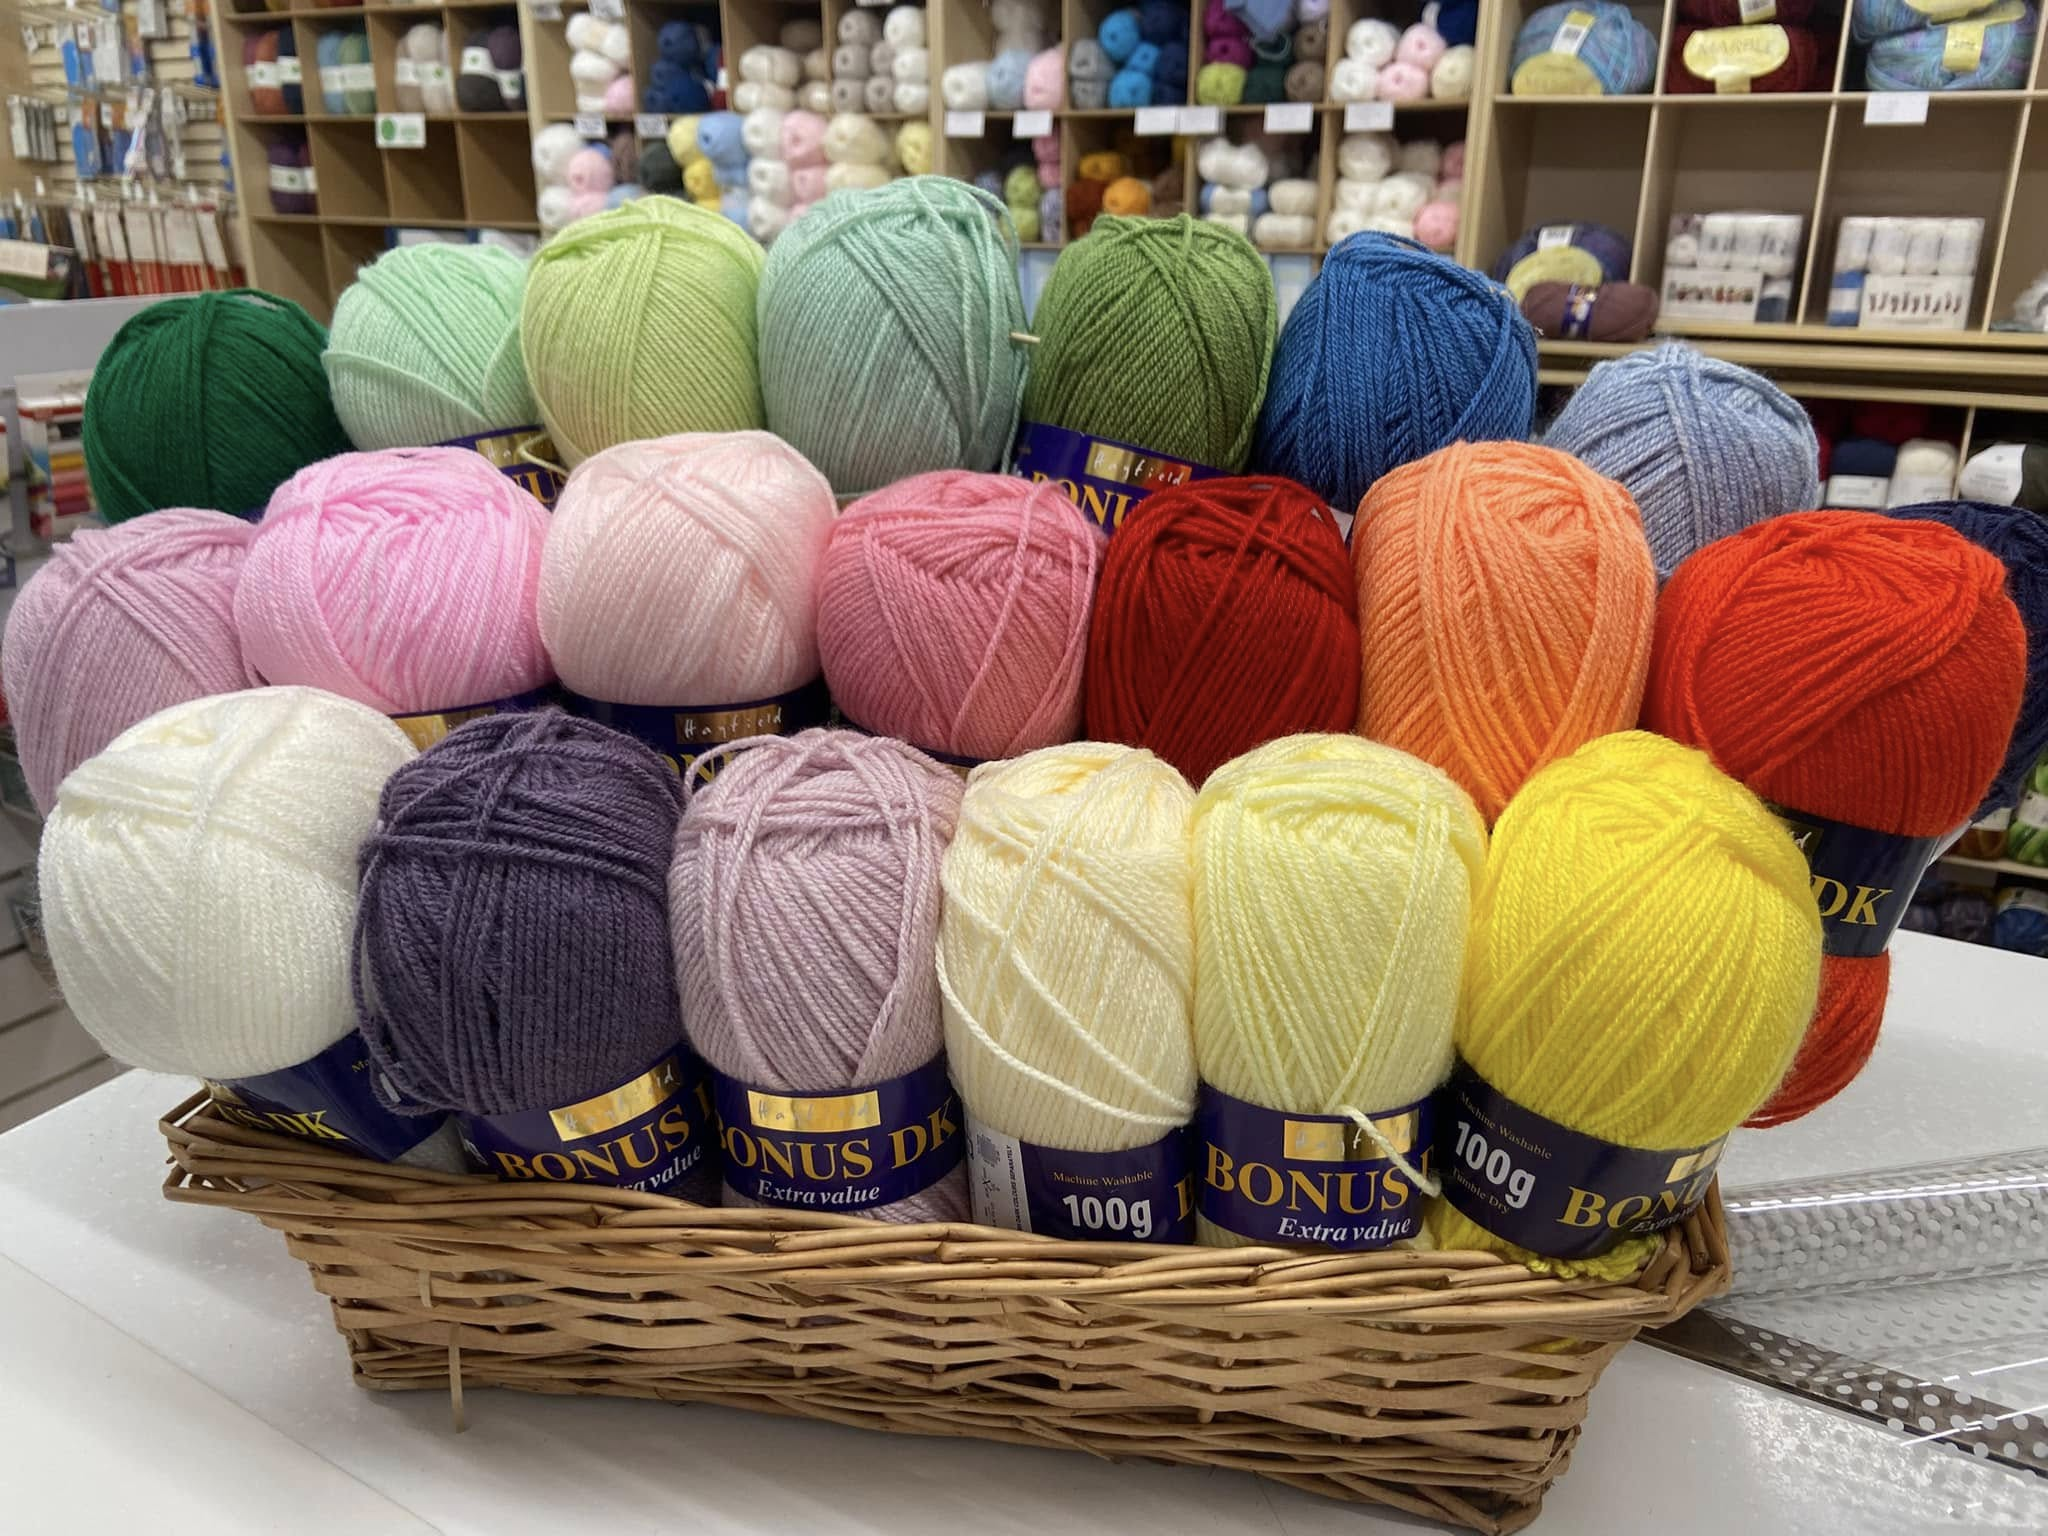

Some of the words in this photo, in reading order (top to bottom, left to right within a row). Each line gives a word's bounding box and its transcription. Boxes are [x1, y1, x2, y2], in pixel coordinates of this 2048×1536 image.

[1093, 451, 1185, 486] Hayfield
[1032, 471, 1142, 529] ONU
[684, 706, 782, 739] Hayfield
[1811, 874, 1894, 926] DK
[263, 1110, 350, 1140] DK
[494, 1104, 690, 1182] BONUS
[888, 1098, 957, 1169] DK
[1499, 1124, 1553, 1160] Washable
[650, 1145, 701, 1188] value
[1053, 1171, 1099, 1186] Machine
[1102, 1170, 1153, 1187] Washable
[1204, 1141, 1410, 1215] BONUS
[1455, 1120, 1536, 1209] 100g
[757, 1179, 816, 1205] Extra
[820, 1186, 880, 1205] value
[1488, 1194, 1511, 1215] Dry
[1556, 1172, 1705, 1229] BONU
[1062, 1194, 1153, 1239] 100g
[1277, 1216, 1347, 1242] Extra
[1352, 1218, 1412, 1242] value
